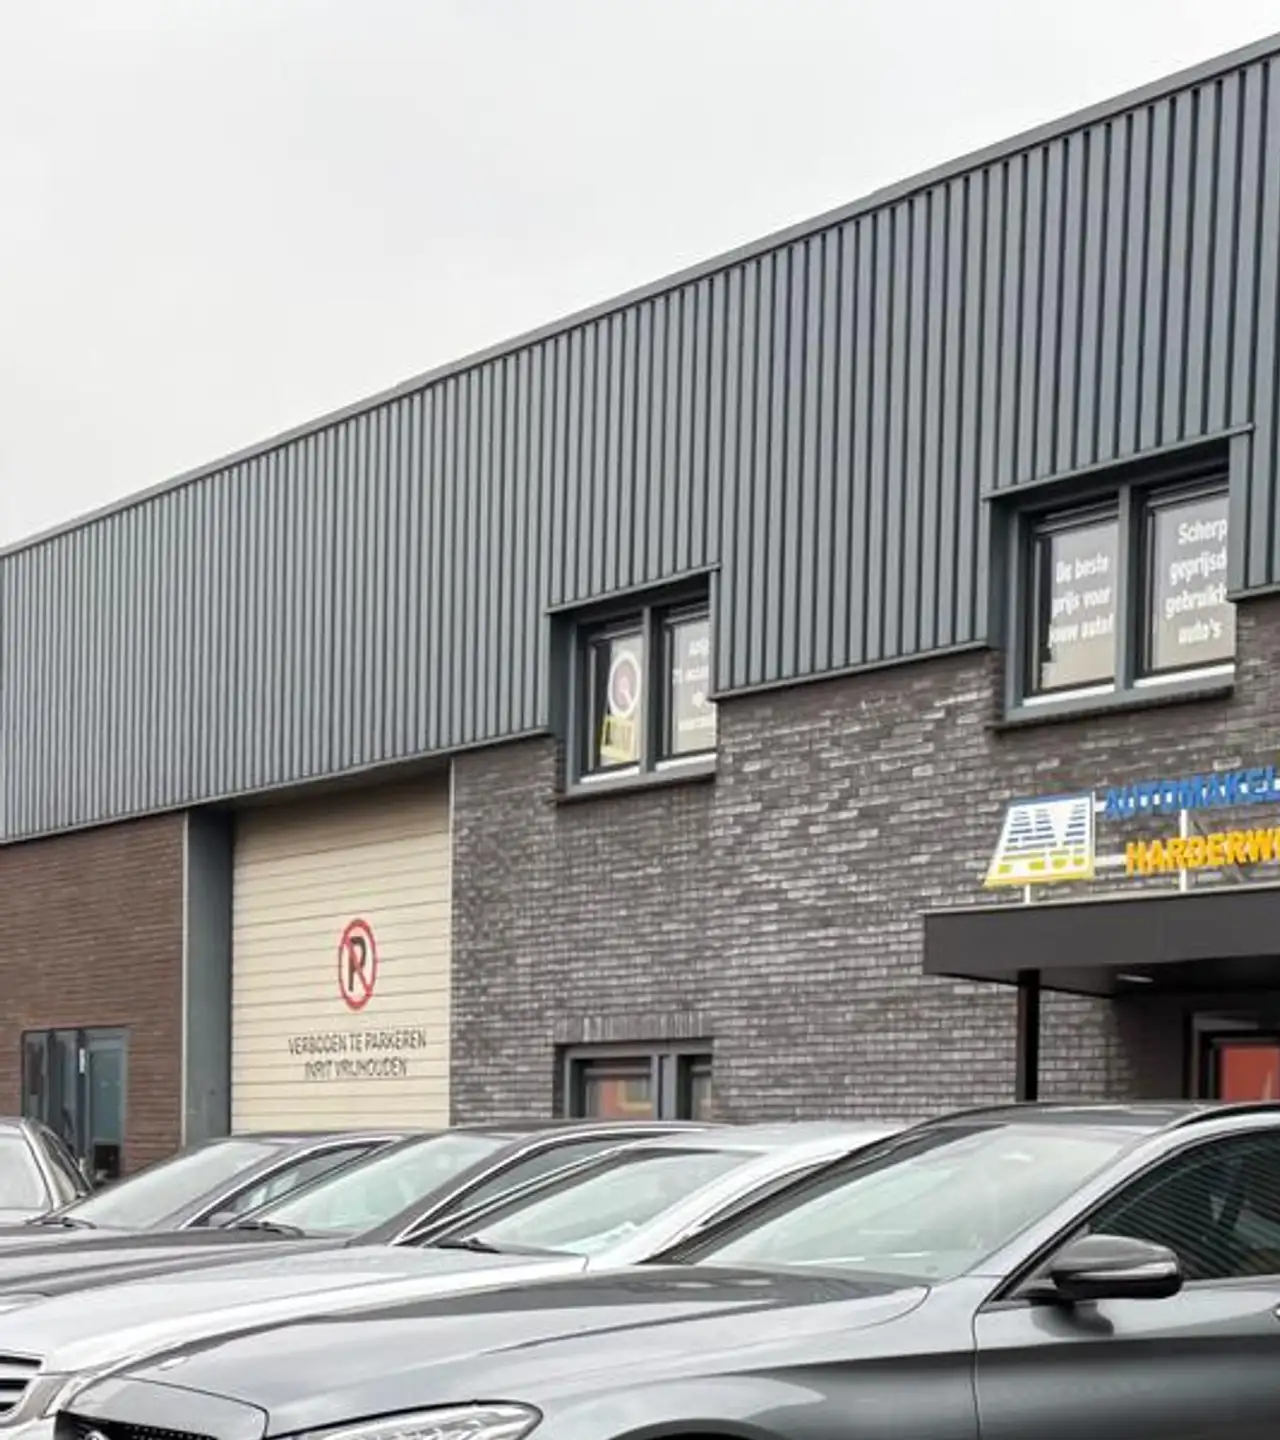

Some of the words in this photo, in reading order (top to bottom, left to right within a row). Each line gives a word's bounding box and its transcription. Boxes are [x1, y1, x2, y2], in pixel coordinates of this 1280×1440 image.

[1178, 519, 1227, 545] Scherp
[287, 1034, 348, 1056] VERBODEN
[348, 1032, 364, 1053] TE
[364, 1028, 428, 1052] PARKEREN
